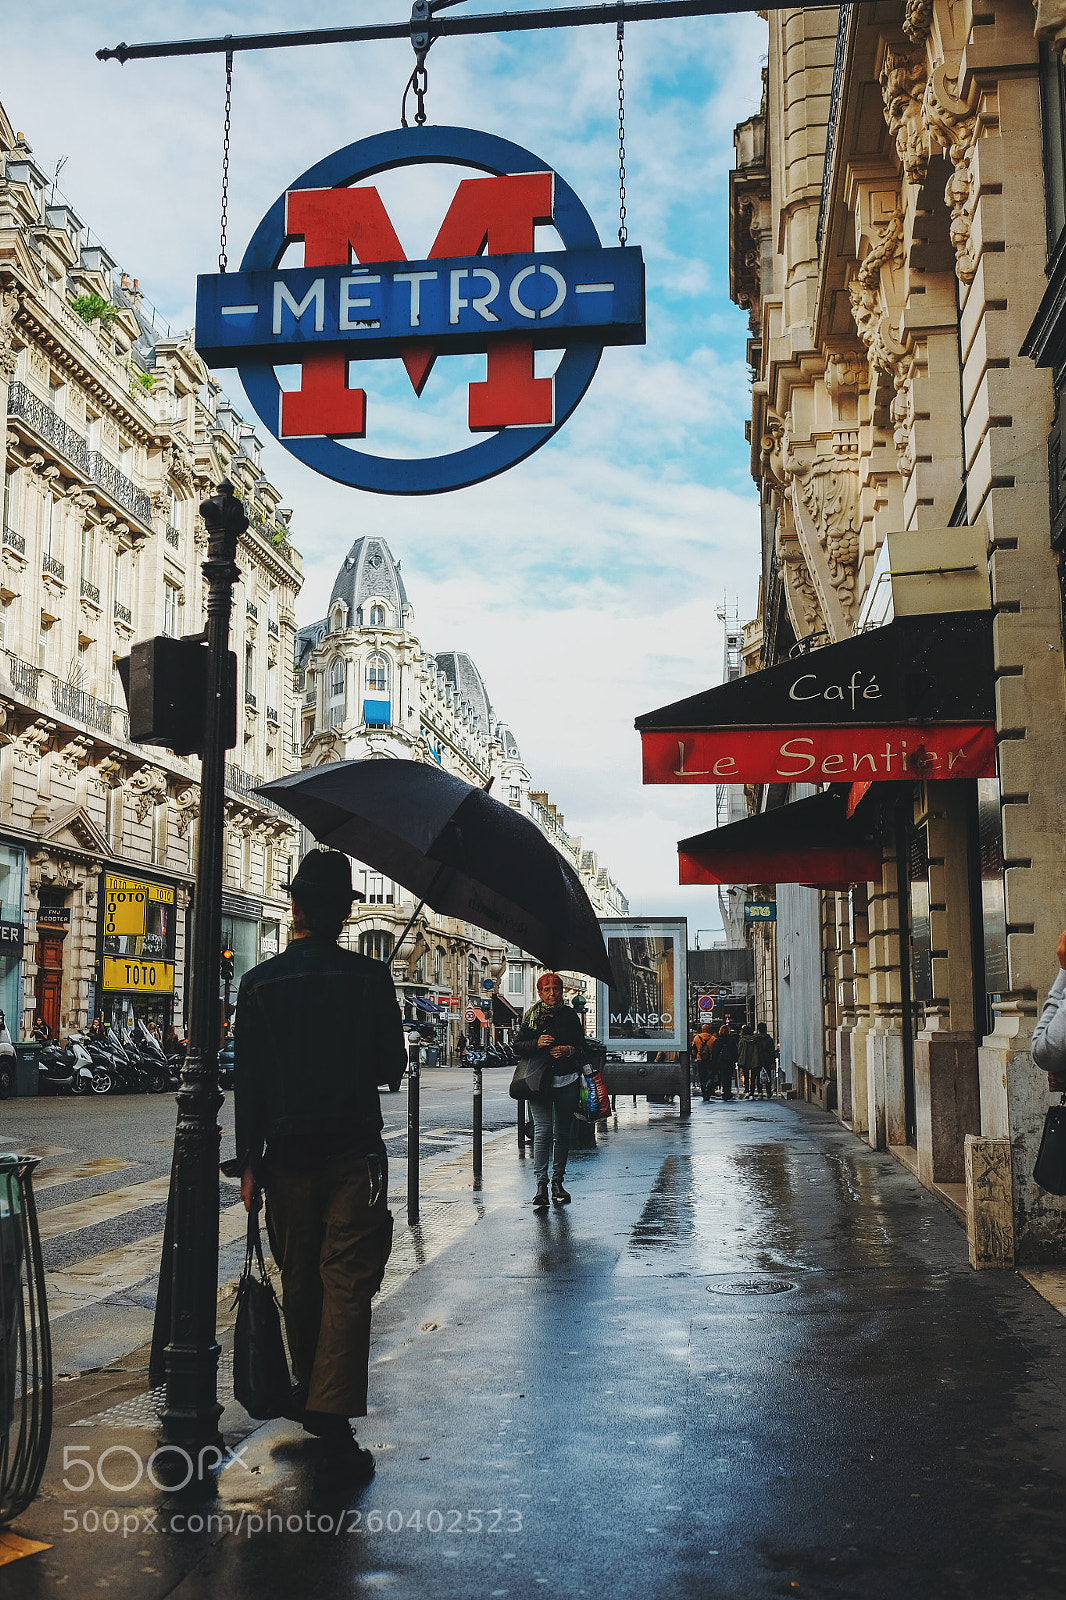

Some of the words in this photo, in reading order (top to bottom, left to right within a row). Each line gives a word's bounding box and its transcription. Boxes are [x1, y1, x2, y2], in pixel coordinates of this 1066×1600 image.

[272, 264, 567, 335] MÉTRO
[279, 171, 555, 439] M
[788, 670, 882, 710] Café
[673, 741, 739, 776] Le
[108, 892, 145, 903] TOTO
[156, 889, 171, 901] TOTO
[0, 926, 19, 942] ER
[124, 964, 156, 986] TOTO
[610, 1012, 673, 1024] MANGO
